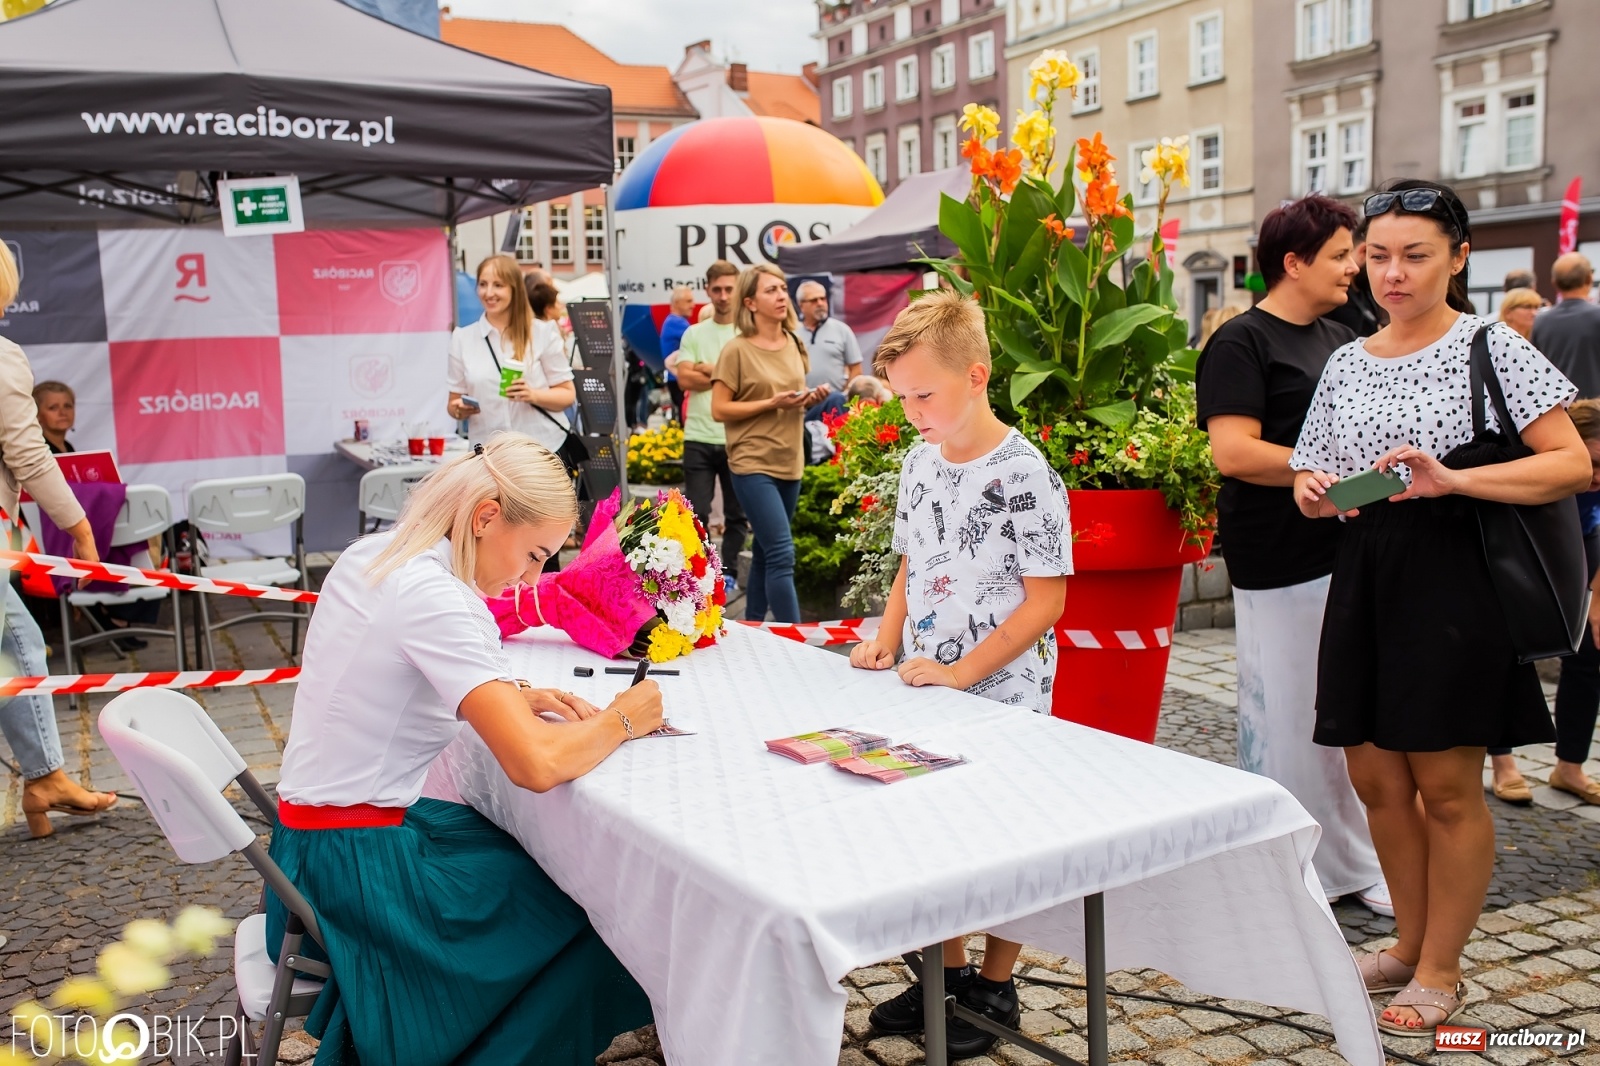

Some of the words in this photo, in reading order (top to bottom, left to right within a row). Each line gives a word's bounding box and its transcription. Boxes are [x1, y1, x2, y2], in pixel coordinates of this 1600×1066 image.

[82, 106, 395, 147] www.raciborz.pl
[1008, 491, 1036, 505] STAR
[1009, 500, 1036, 513] WARS
